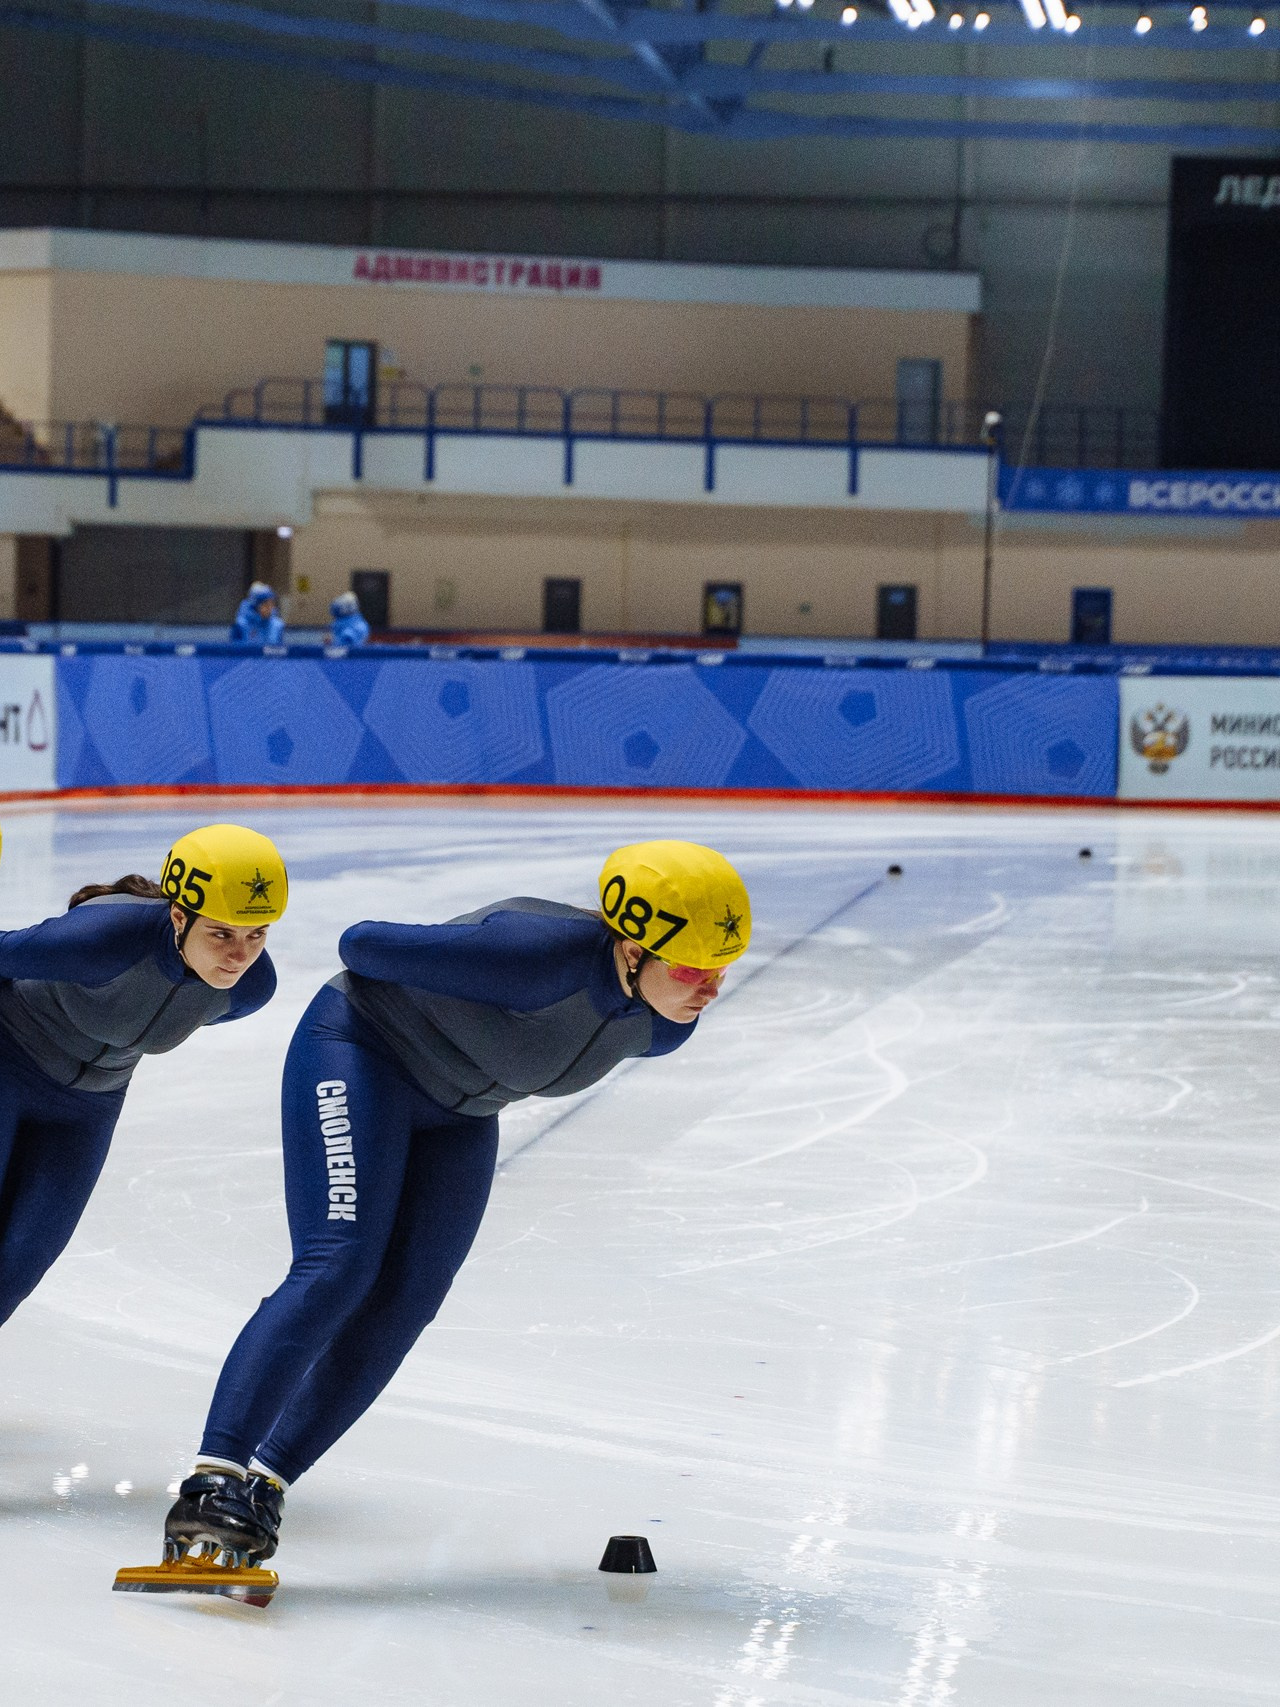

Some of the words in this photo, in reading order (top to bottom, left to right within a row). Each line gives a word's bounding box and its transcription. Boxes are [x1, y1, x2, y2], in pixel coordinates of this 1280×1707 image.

[353, 254, 602, 290] АДМИНИСТРАЦИЯ
[1210, 745, 1280, 770] РОССИ
[601, 875, 688, 952] 087
[315, 1080, 358, 1222] СМОЛЕНСК
